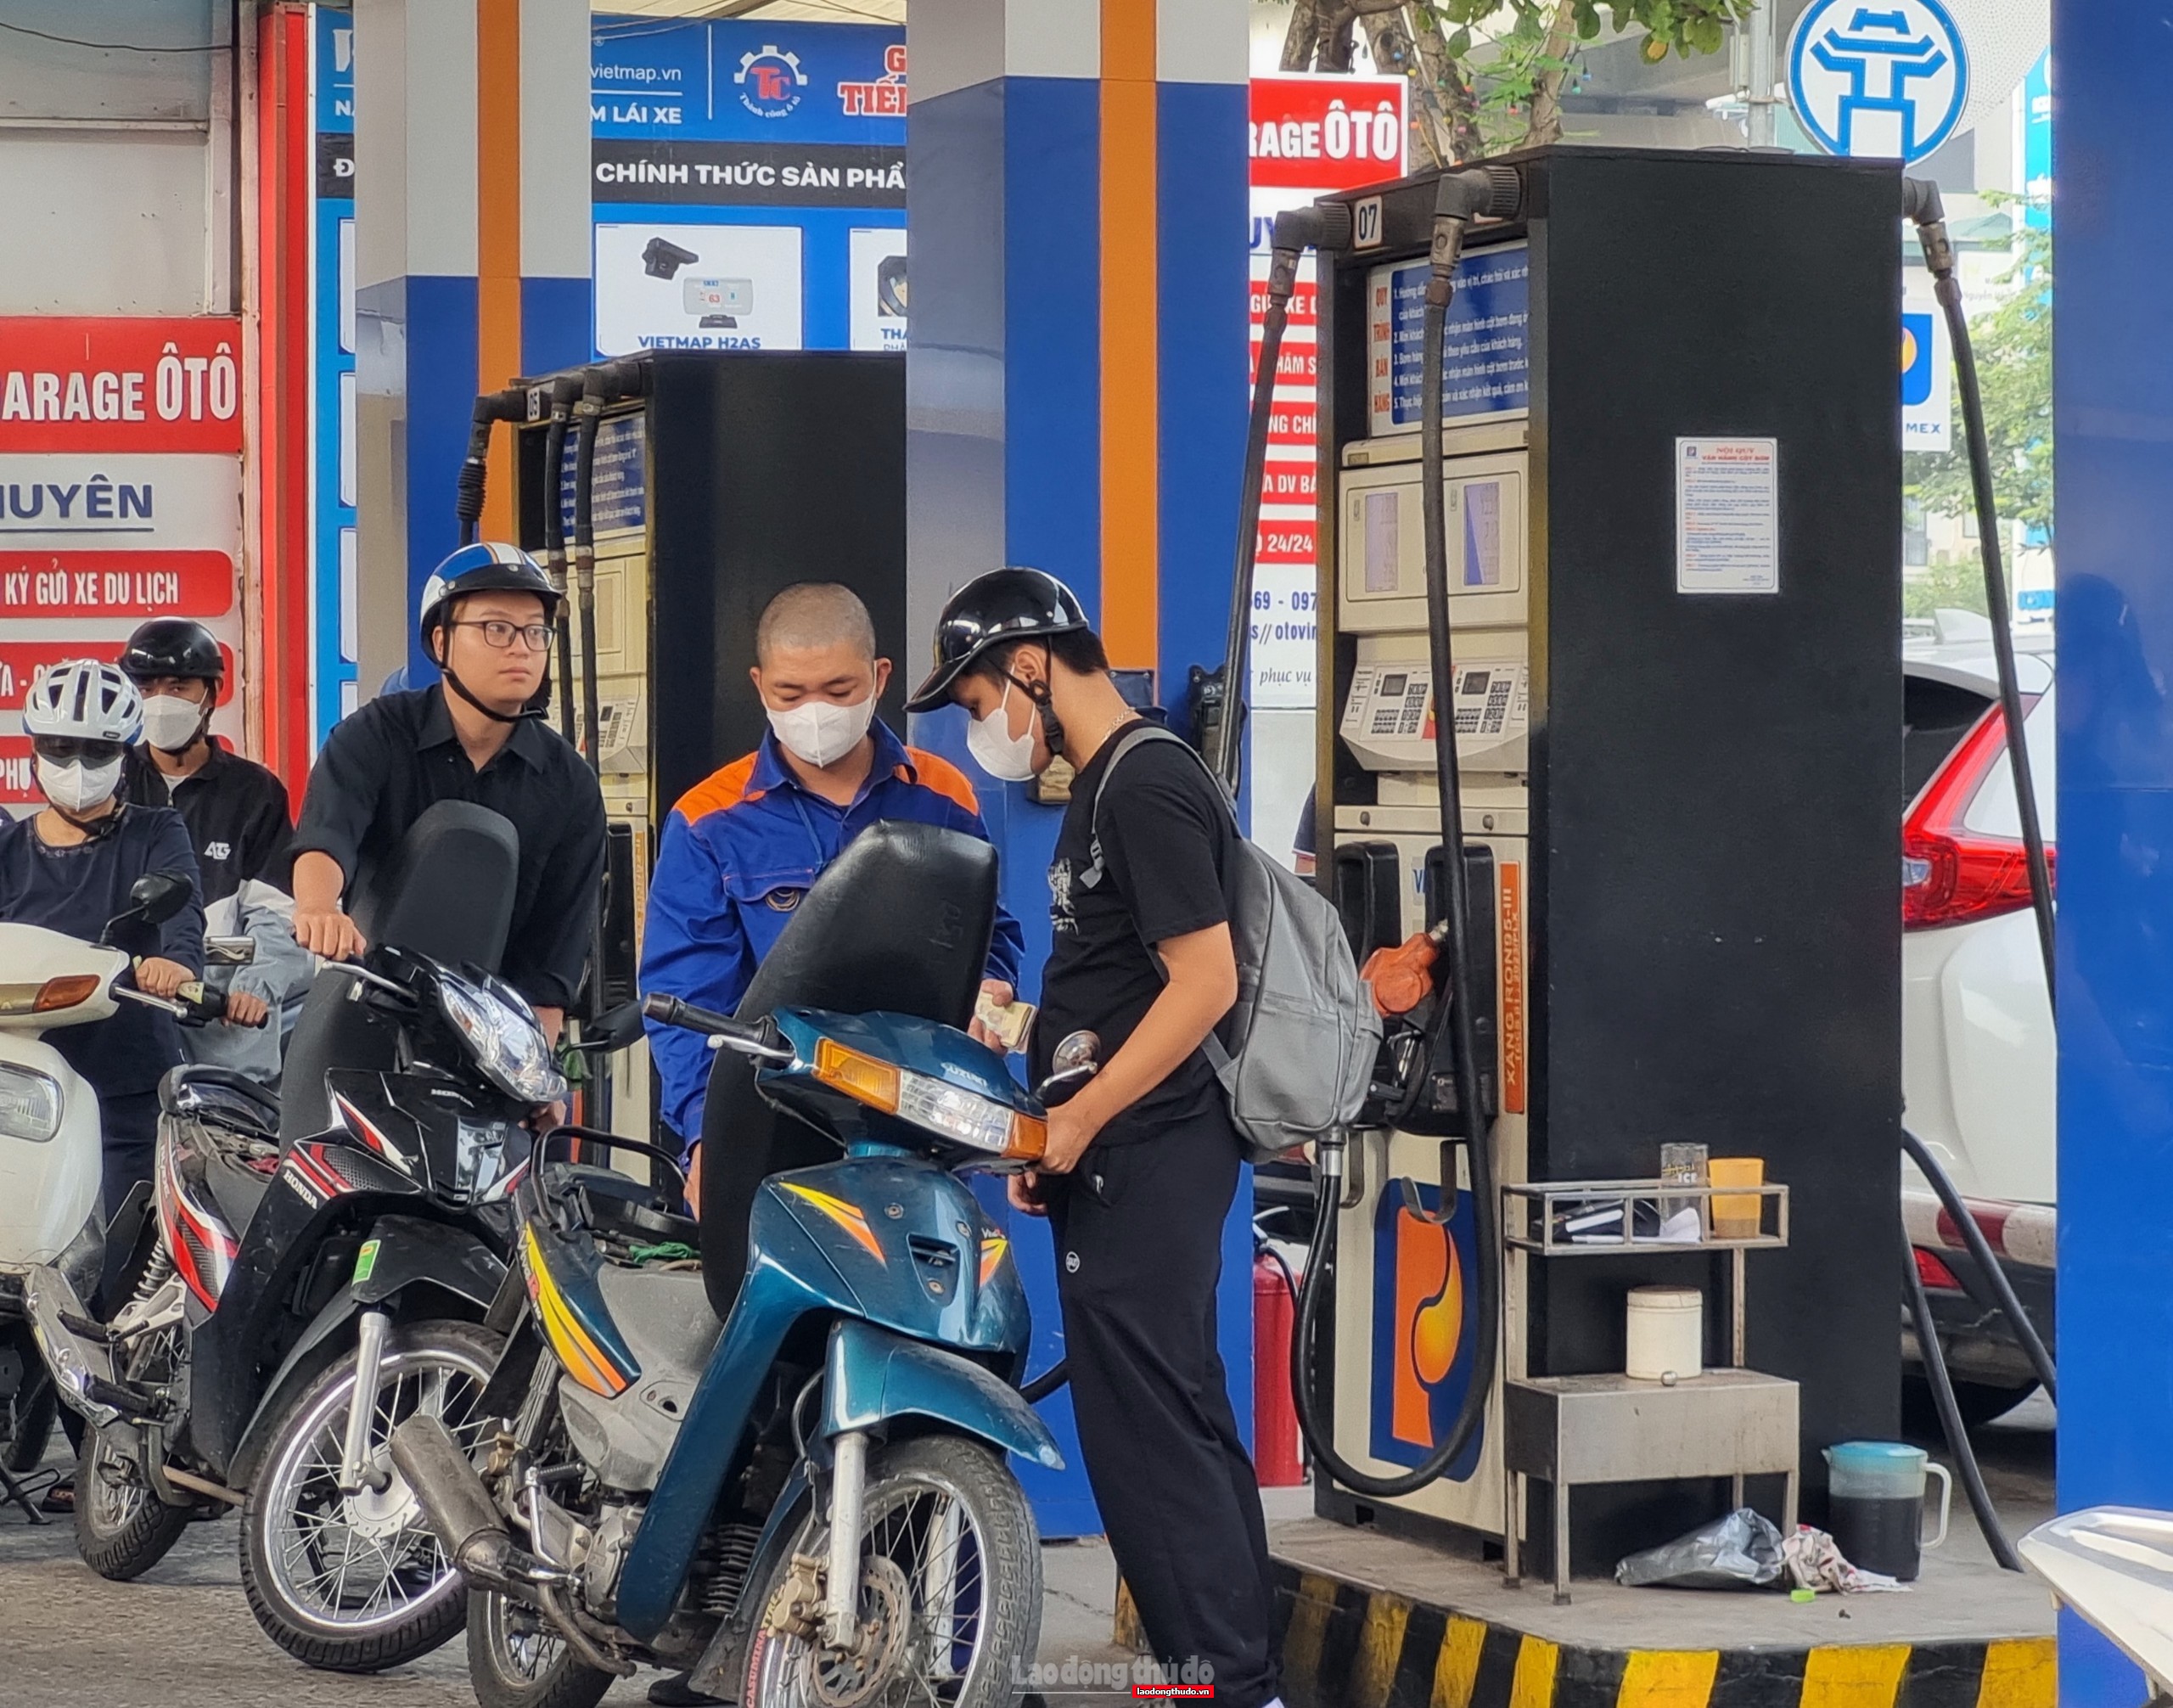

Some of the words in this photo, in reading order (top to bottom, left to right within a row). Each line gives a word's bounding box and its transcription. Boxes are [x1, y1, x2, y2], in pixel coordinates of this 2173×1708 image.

[591, 63, 682, 83] vietmap.vn
[613, 103, 647, 123] LÁI
[653, 107, 682, 124] XE
[1324, 98, 1398, 161] ÔTÔ
[595, 159, 688, 184] CHÍNH
[694, 161, 776, 187] THỨC
[781, 161, 840, 188] SẢN
[1358, 203, 1378, 241] 07
[638, 336, 712, 348] VIETMAP
[718, 337, 761, 350] H2AS
[2, 371, 145, 420] ARAGE
[156, 341, 237, 421] ÔTÔ
[1906, 423, 1940, 435] MEX
[0, 473, 153, 519] UYÊN
[1278, 475, 1296, 492] DV
[1267, 535, 1313, 552] 24/24
[5, 565, 29, 605] KÝ
[36, 557, 69, 605] GỬI
[74, 571, 98, 605] XE
[104, 571, 130, 605] DU
[136, 571, 179, 612] LỊCH
[1260, 667, 1291, 686] phục
[1296, 671, 1311, 686] vụ
[283, 1168, 319, 1210] HONDA
